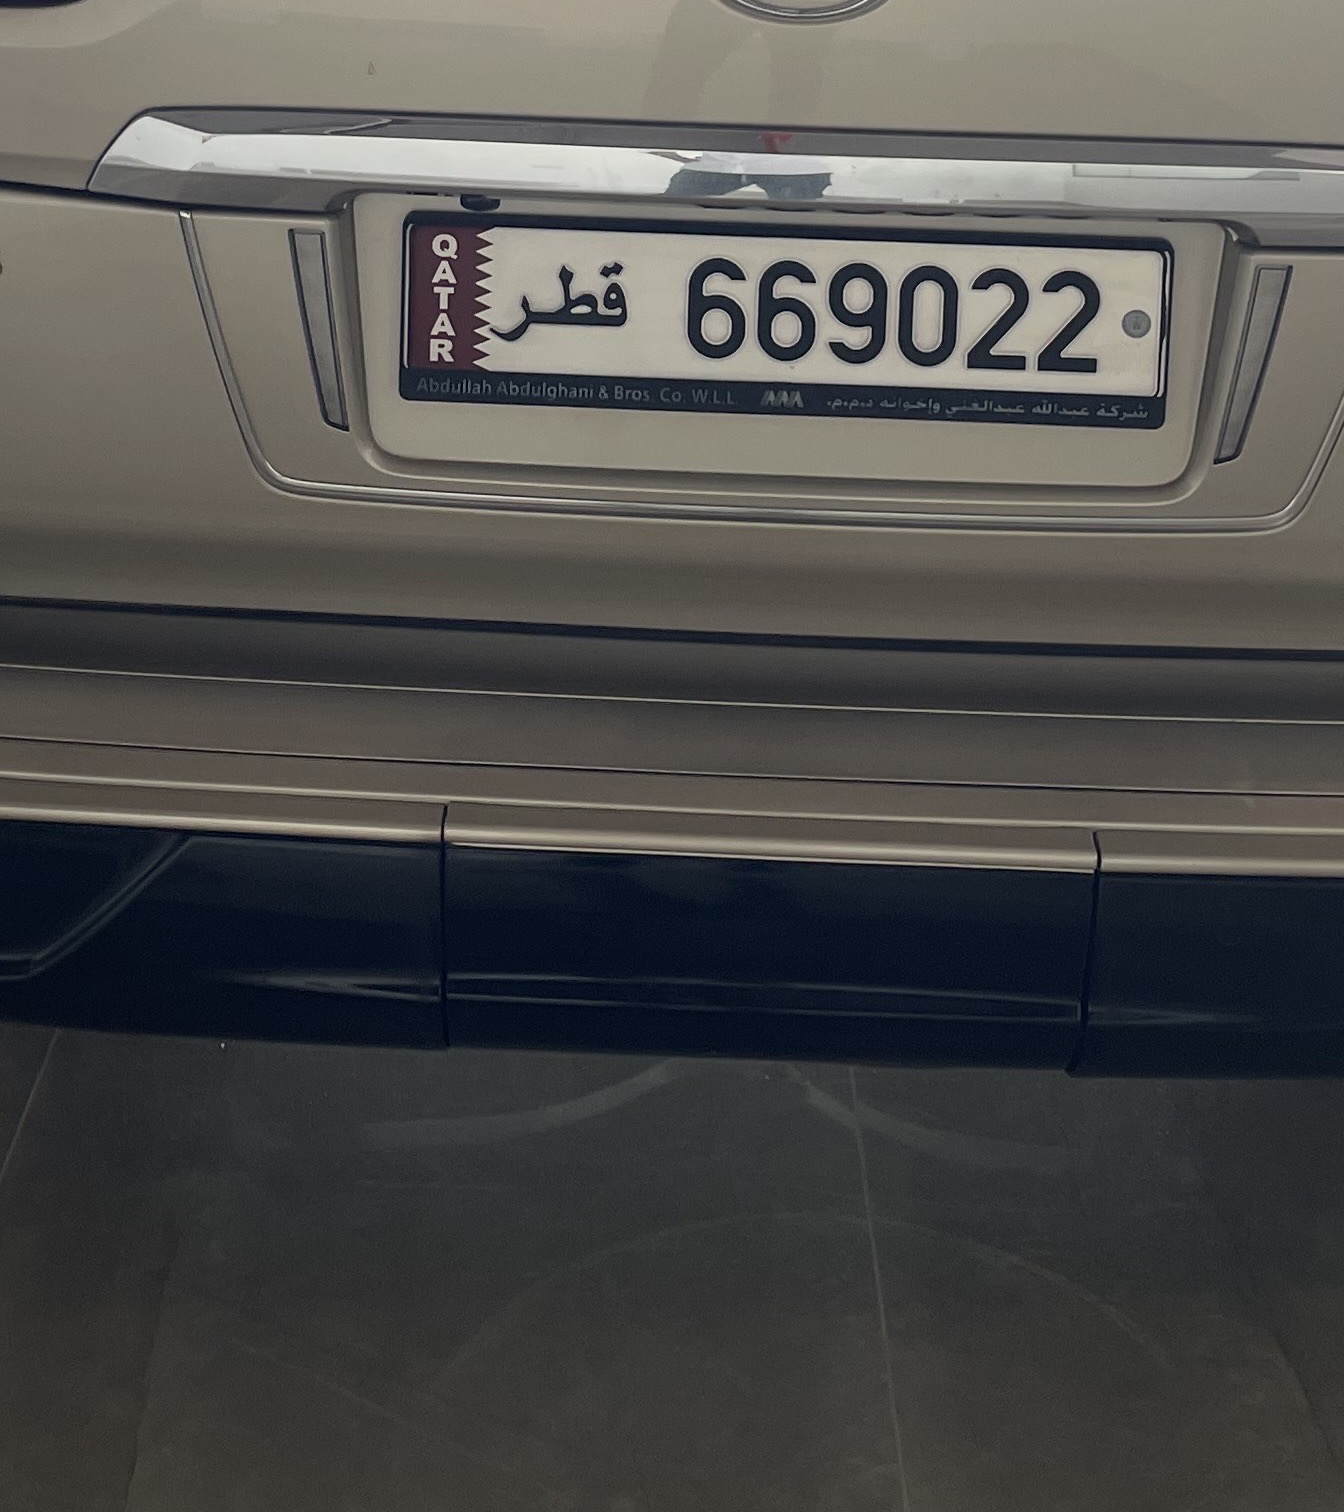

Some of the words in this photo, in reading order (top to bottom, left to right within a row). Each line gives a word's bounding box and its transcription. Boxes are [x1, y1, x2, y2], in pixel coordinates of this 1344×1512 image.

[429, 233, 459, 363] QATAR
[489, 261, 628, 342] قطر
[685, 257, 1102, 375] 669022
[416, 377, 493, 396] Abdullah
[497, 379, 594, 404] Abdulghani
[599, 384, 610, 400] &
[1095, 401, 1149, 421] شركة
